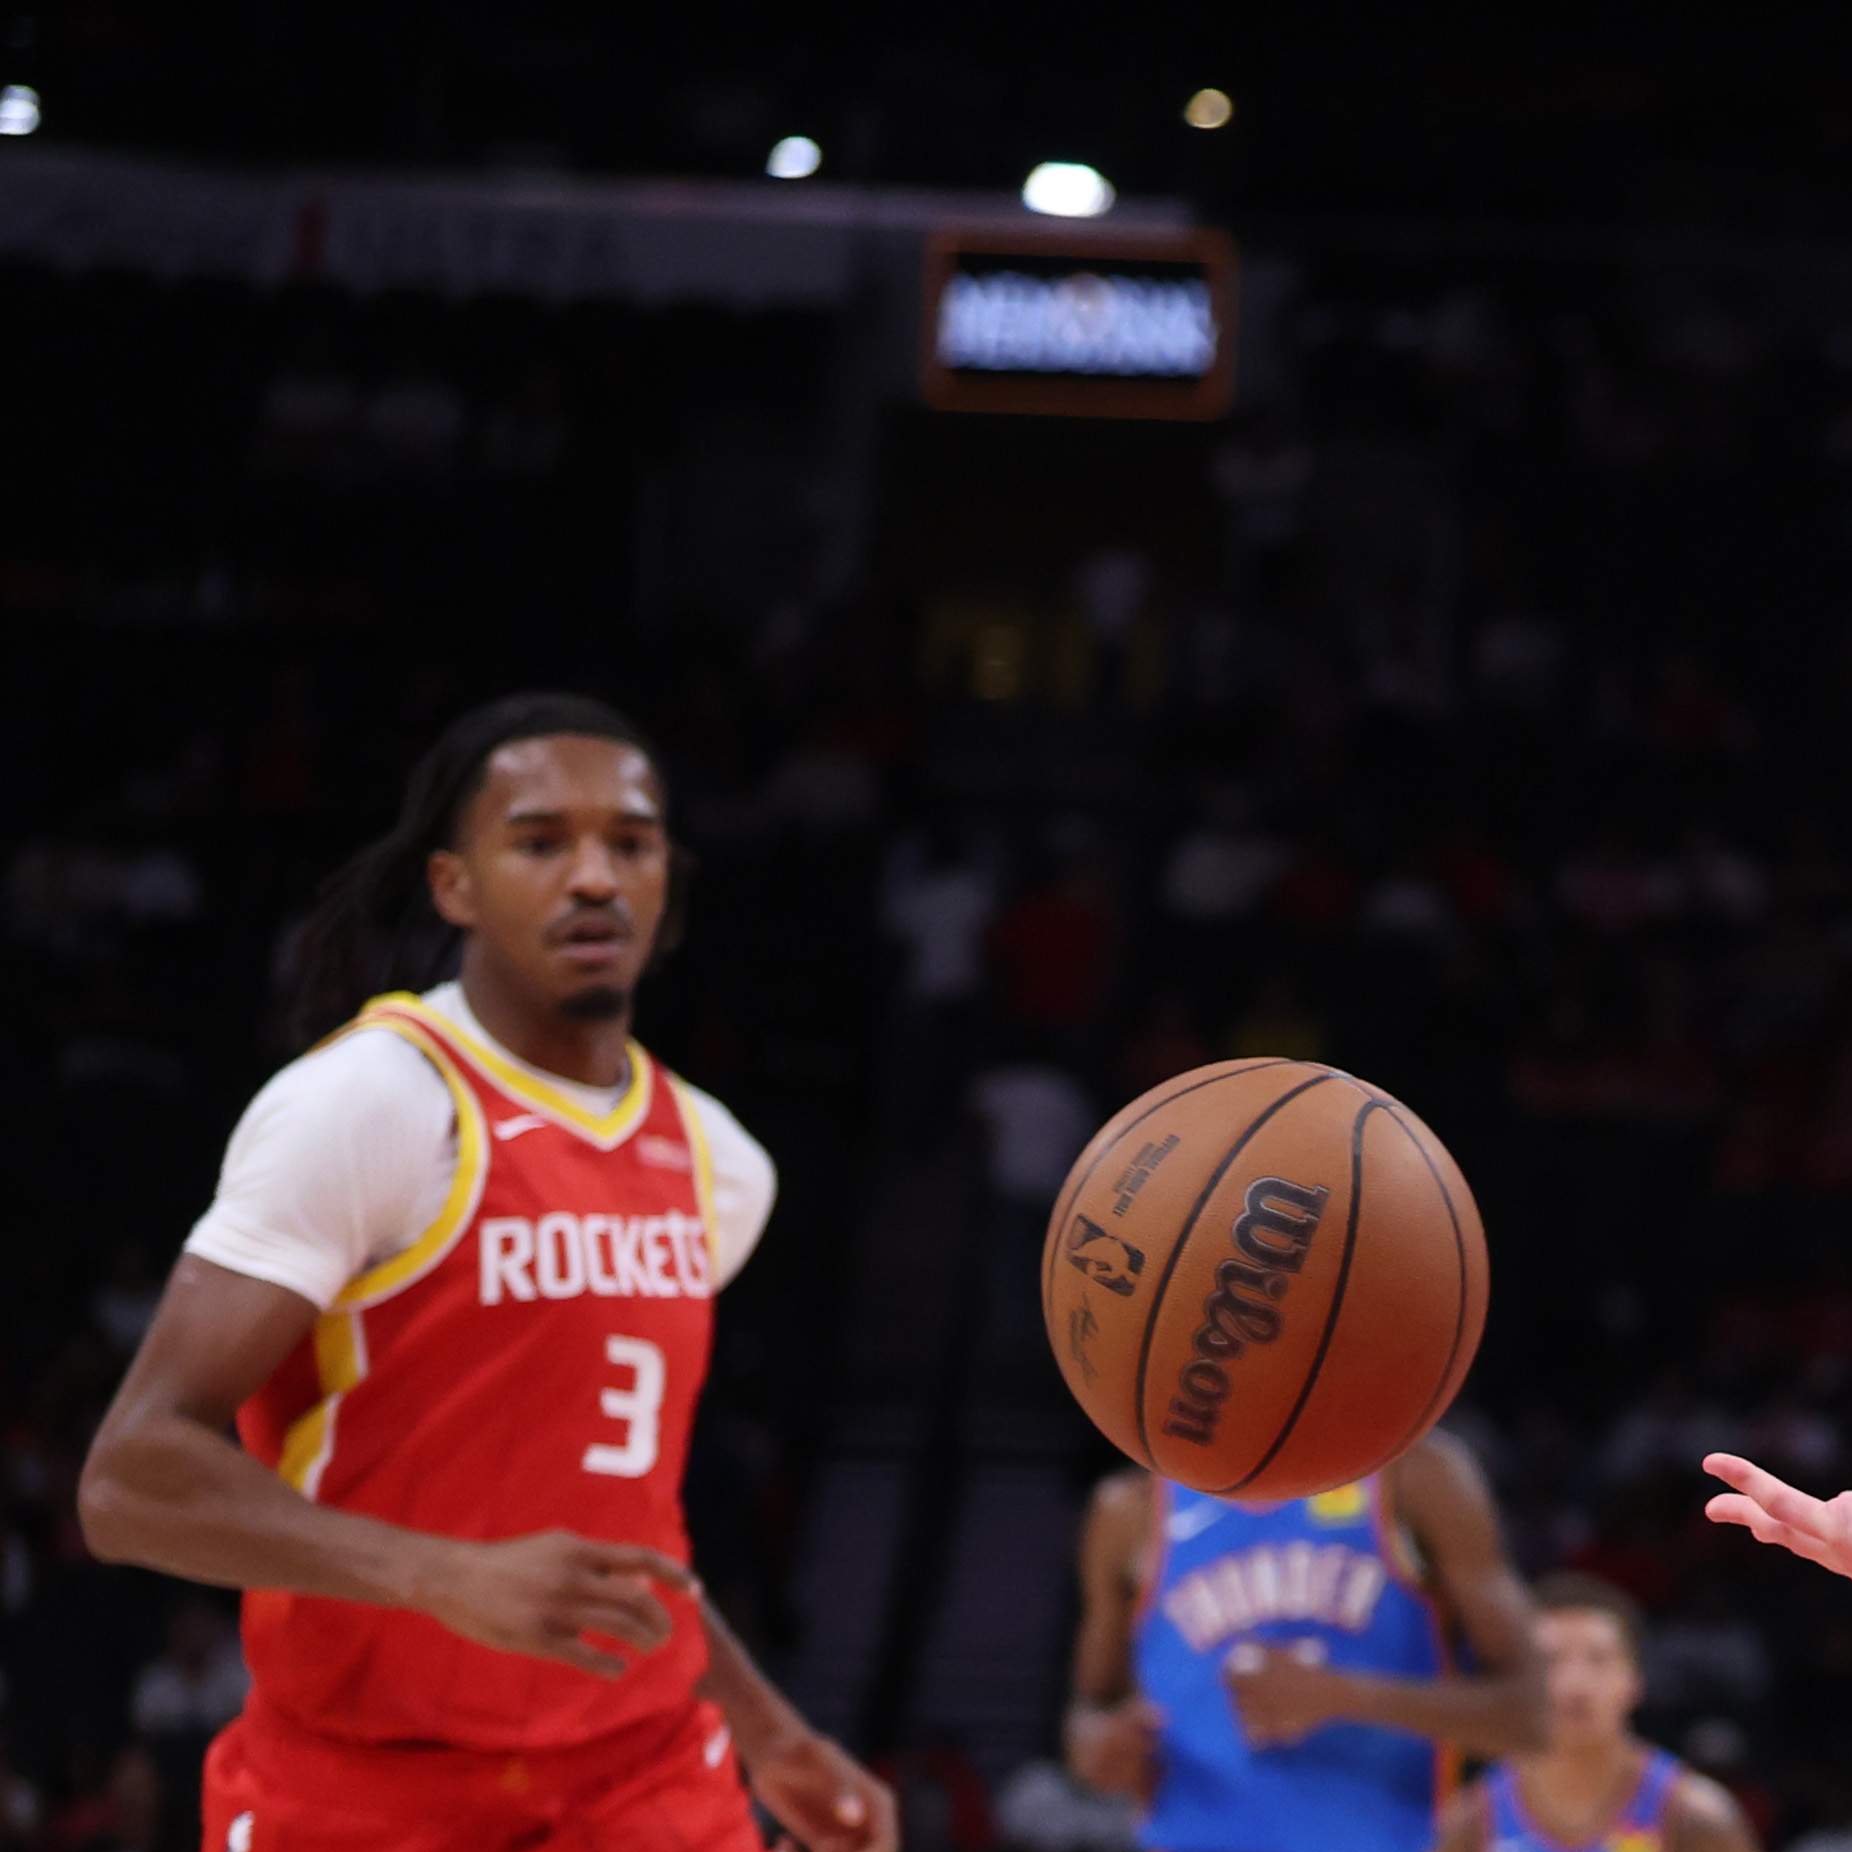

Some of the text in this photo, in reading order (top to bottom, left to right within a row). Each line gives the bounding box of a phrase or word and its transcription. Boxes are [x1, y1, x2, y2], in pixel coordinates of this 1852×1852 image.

[479, 1209, 714, 1305] ROCKETS
[1163, 1175, 1330, 1446] Wilson
[582, 1333, 666, 1478] 3
